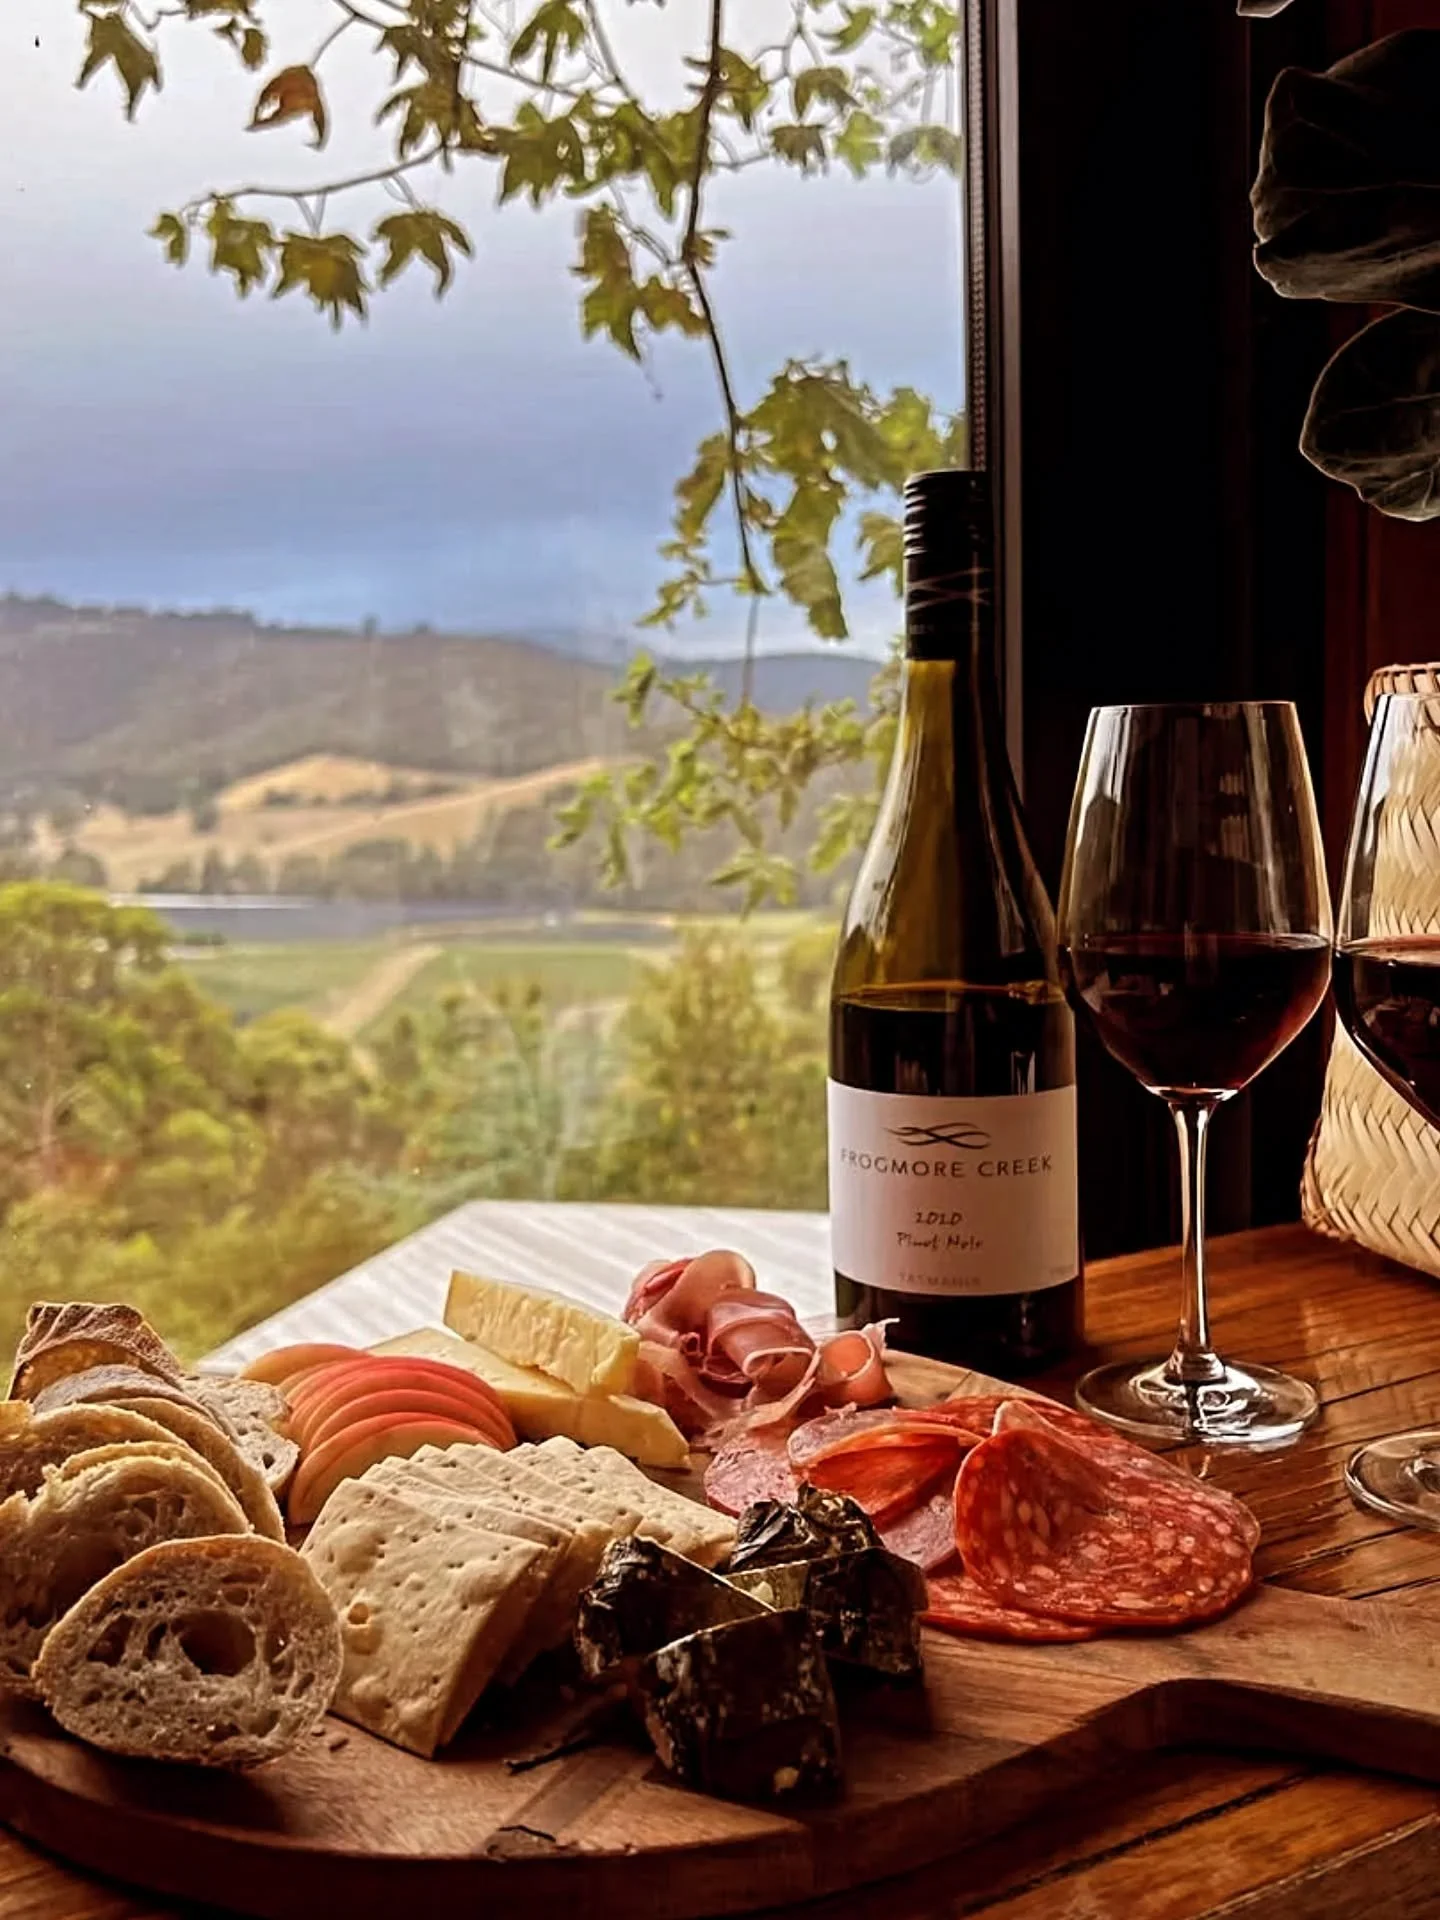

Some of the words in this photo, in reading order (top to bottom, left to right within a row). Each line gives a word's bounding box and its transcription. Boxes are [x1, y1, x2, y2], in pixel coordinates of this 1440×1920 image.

[839, 1149, 966, 1178] FROGMORE
[977, 1155, 1052, 1178] CREEK
[896, 1231, 938, 1251] Pinot
